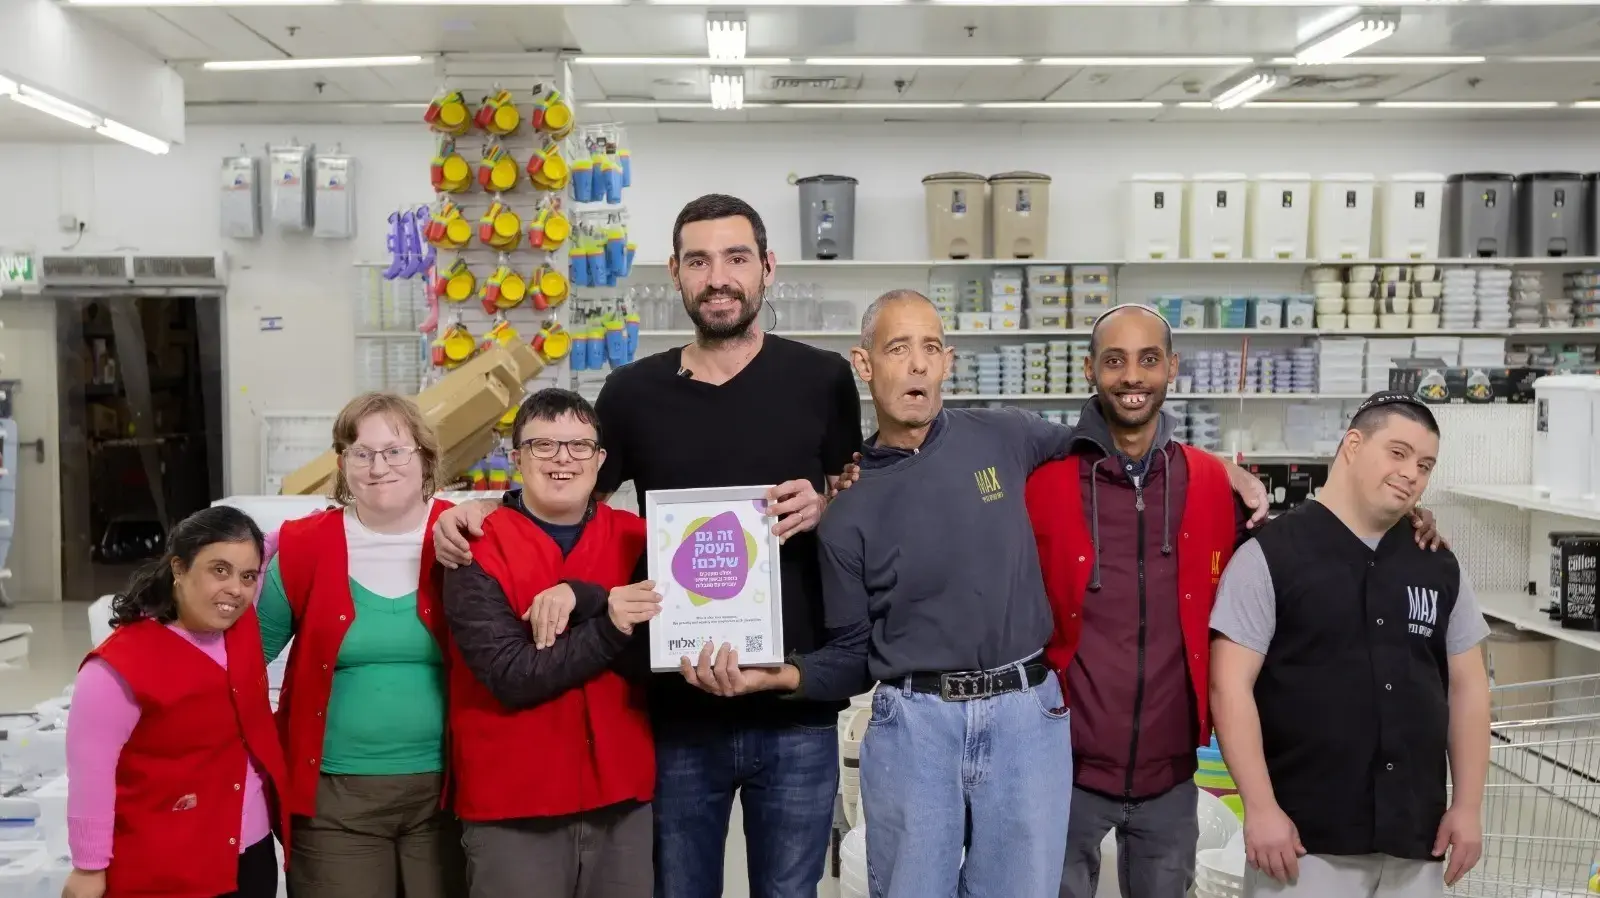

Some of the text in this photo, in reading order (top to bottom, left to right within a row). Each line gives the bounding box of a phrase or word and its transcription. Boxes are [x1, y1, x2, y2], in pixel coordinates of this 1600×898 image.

[974, 466, 1001, 494] MAX
[694, 530, 734, 542] זה גם
[694, 542, 735, 558] העסק
[692, 556, 739, 570] שלכם!
[1211, 550, 1221, 574] AX
[1567, 583, 1596, 597] PREMIUM
[1407, 585, 1439, 626] MAX
[669, 637, 696, 650] אלווין
